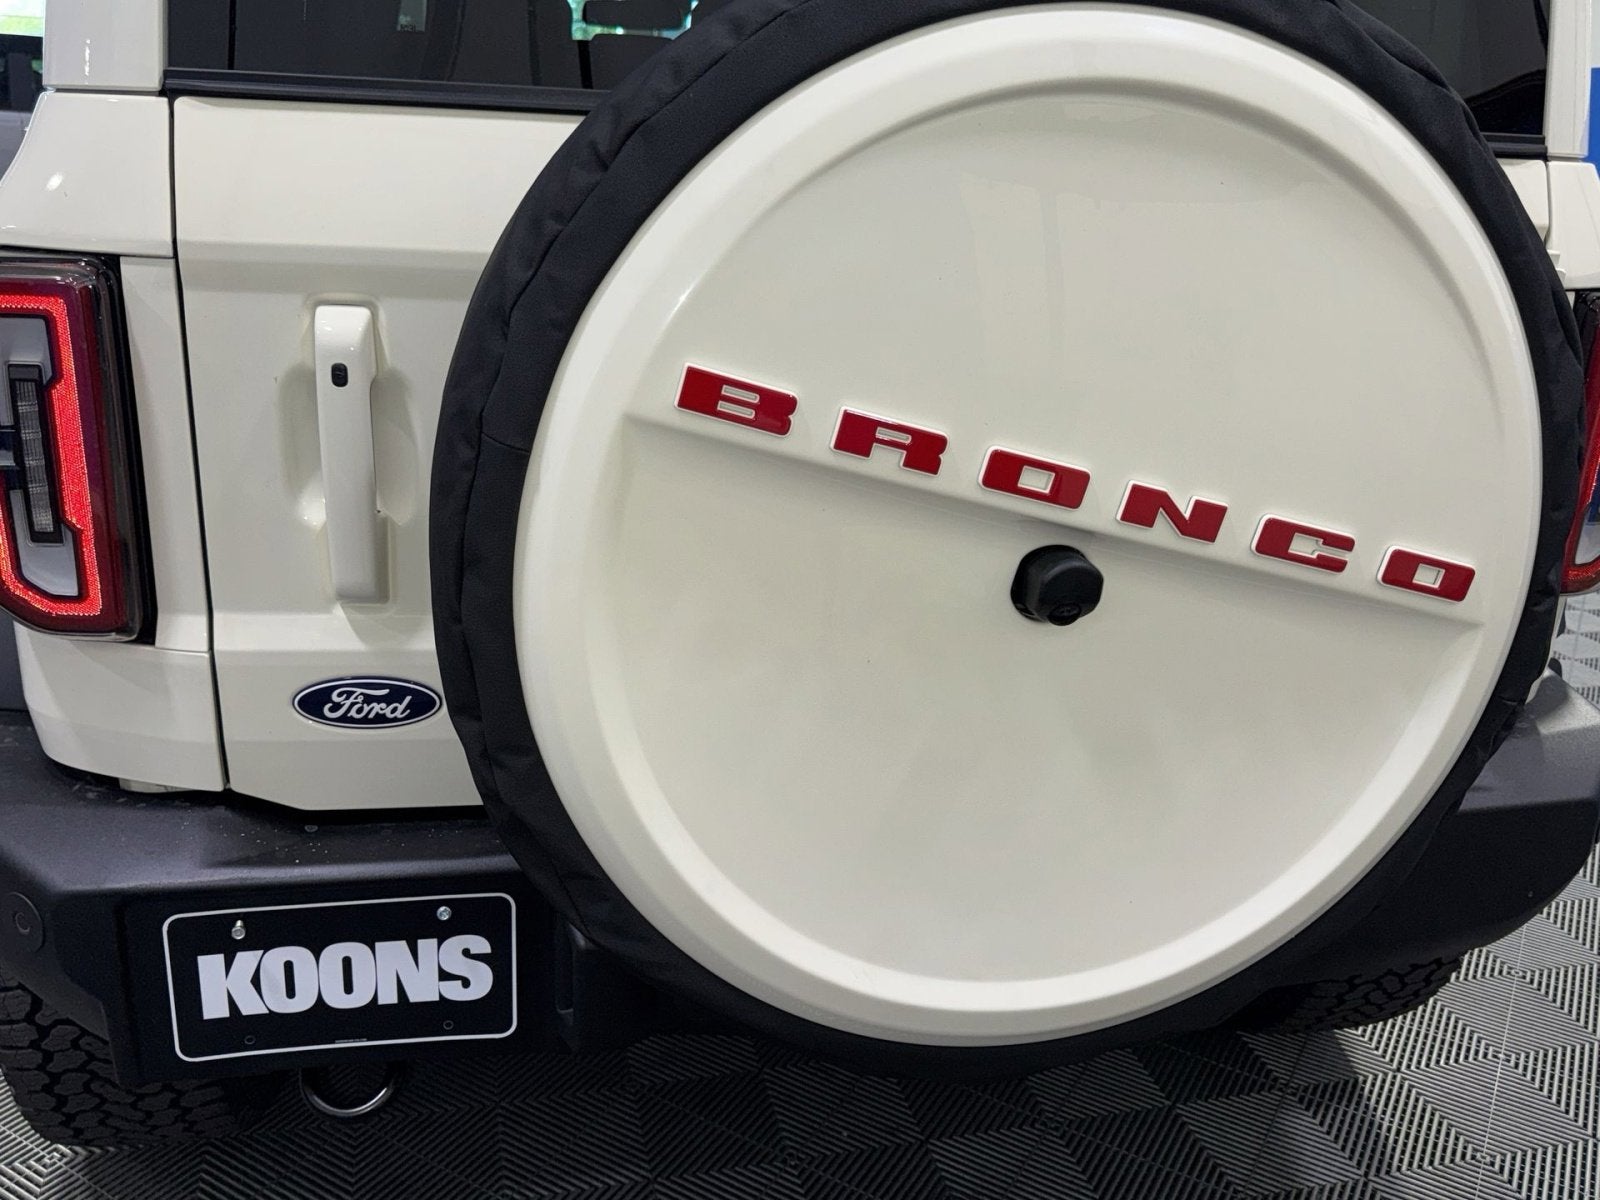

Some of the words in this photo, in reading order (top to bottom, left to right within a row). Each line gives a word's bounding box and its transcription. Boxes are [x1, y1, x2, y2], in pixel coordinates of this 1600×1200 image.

[675, 363, 1477, 602] BRONCO
[323, 687, 412, 719] Ford
[197, 934, 494, 1020] KOONS
